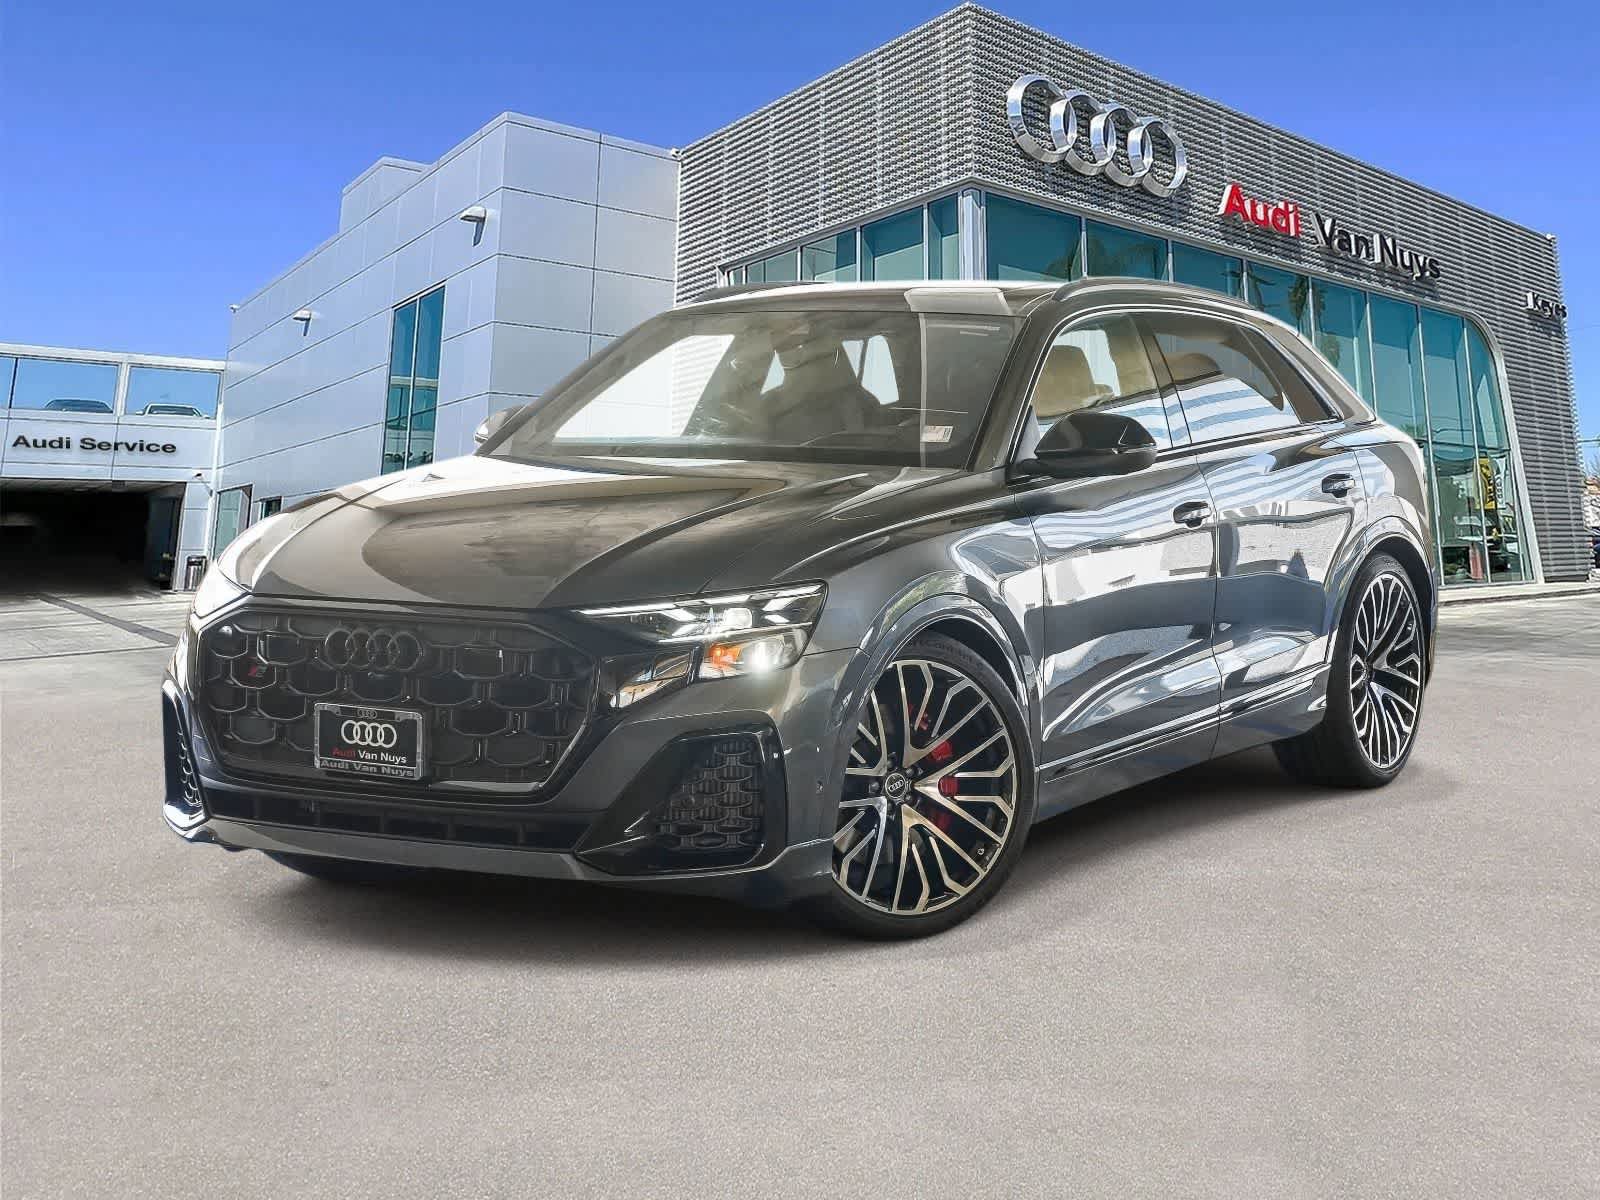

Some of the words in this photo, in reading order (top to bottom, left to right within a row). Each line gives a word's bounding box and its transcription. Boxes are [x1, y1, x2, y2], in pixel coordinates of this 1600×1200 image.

[1218, 182, 1301, 238] Audi
[1311, 211, 1371, 258] Van
[1374, 232, 1441, 280] Nuys
[12, 435, 71, 450] Audi
[80, 437, 177, 453] Service
[332, 748, 356, 758] Audi
[357, 750, 378, 760] Van
[380, 753, 407, 764] Nuys
[321, 760, 349, 769] Audi
[353, 763, 377, 773] Van
[381, 767, 413, 777] Nuys
